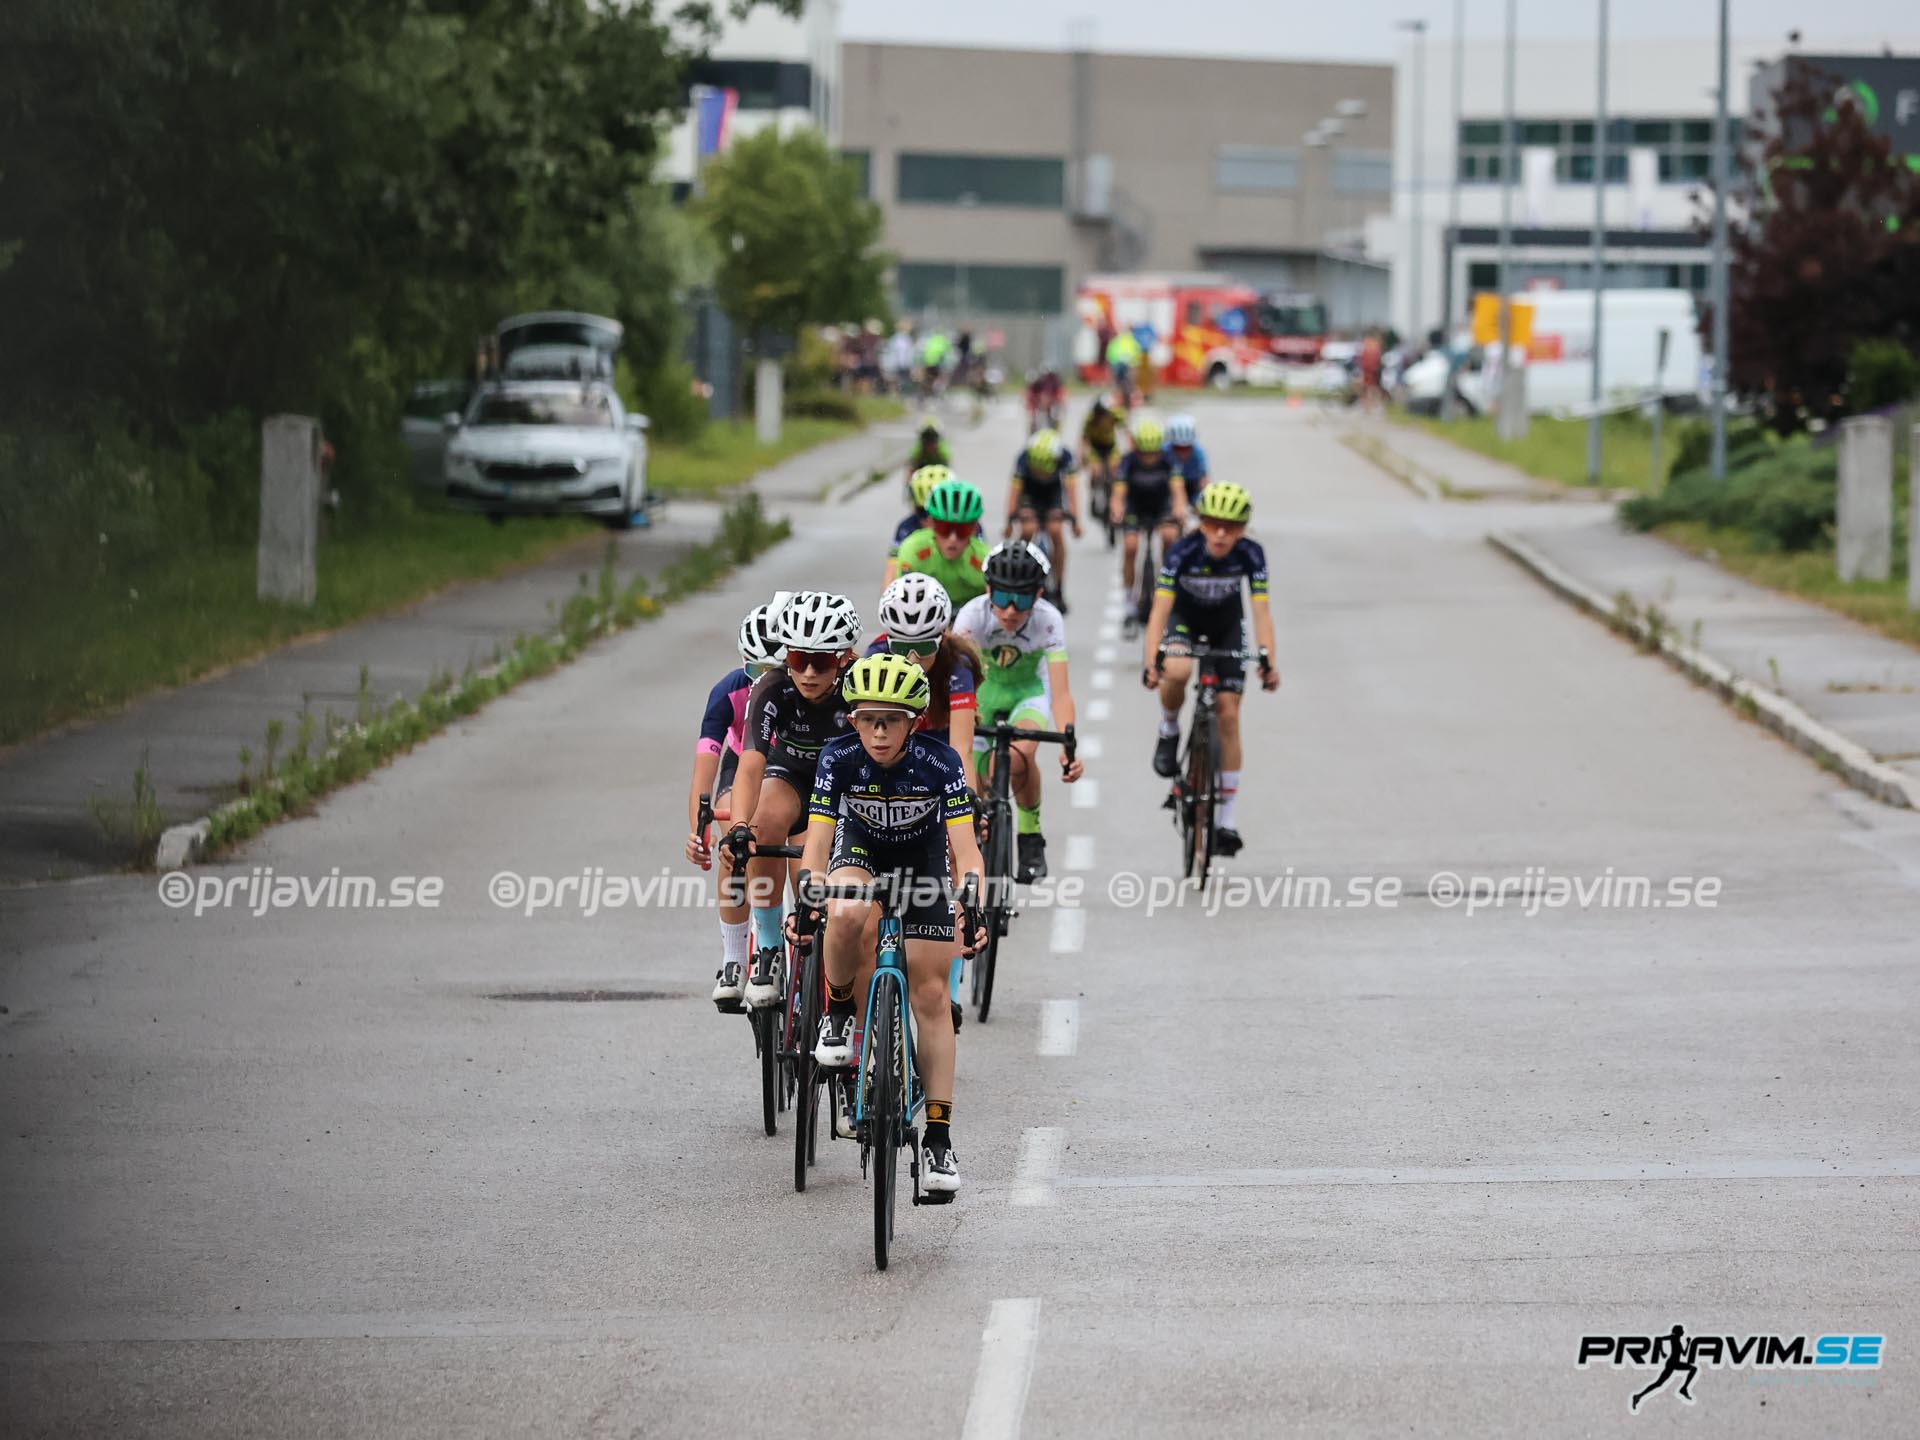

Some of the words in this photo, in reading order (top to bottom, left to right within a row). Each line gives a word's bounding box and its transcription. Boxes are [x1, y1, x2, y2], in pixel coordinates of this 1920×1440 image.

[761, 715, 771, 741] triglav
[786, 746, 817, 760] BTC
[834, 744, 860, 759] Plume
